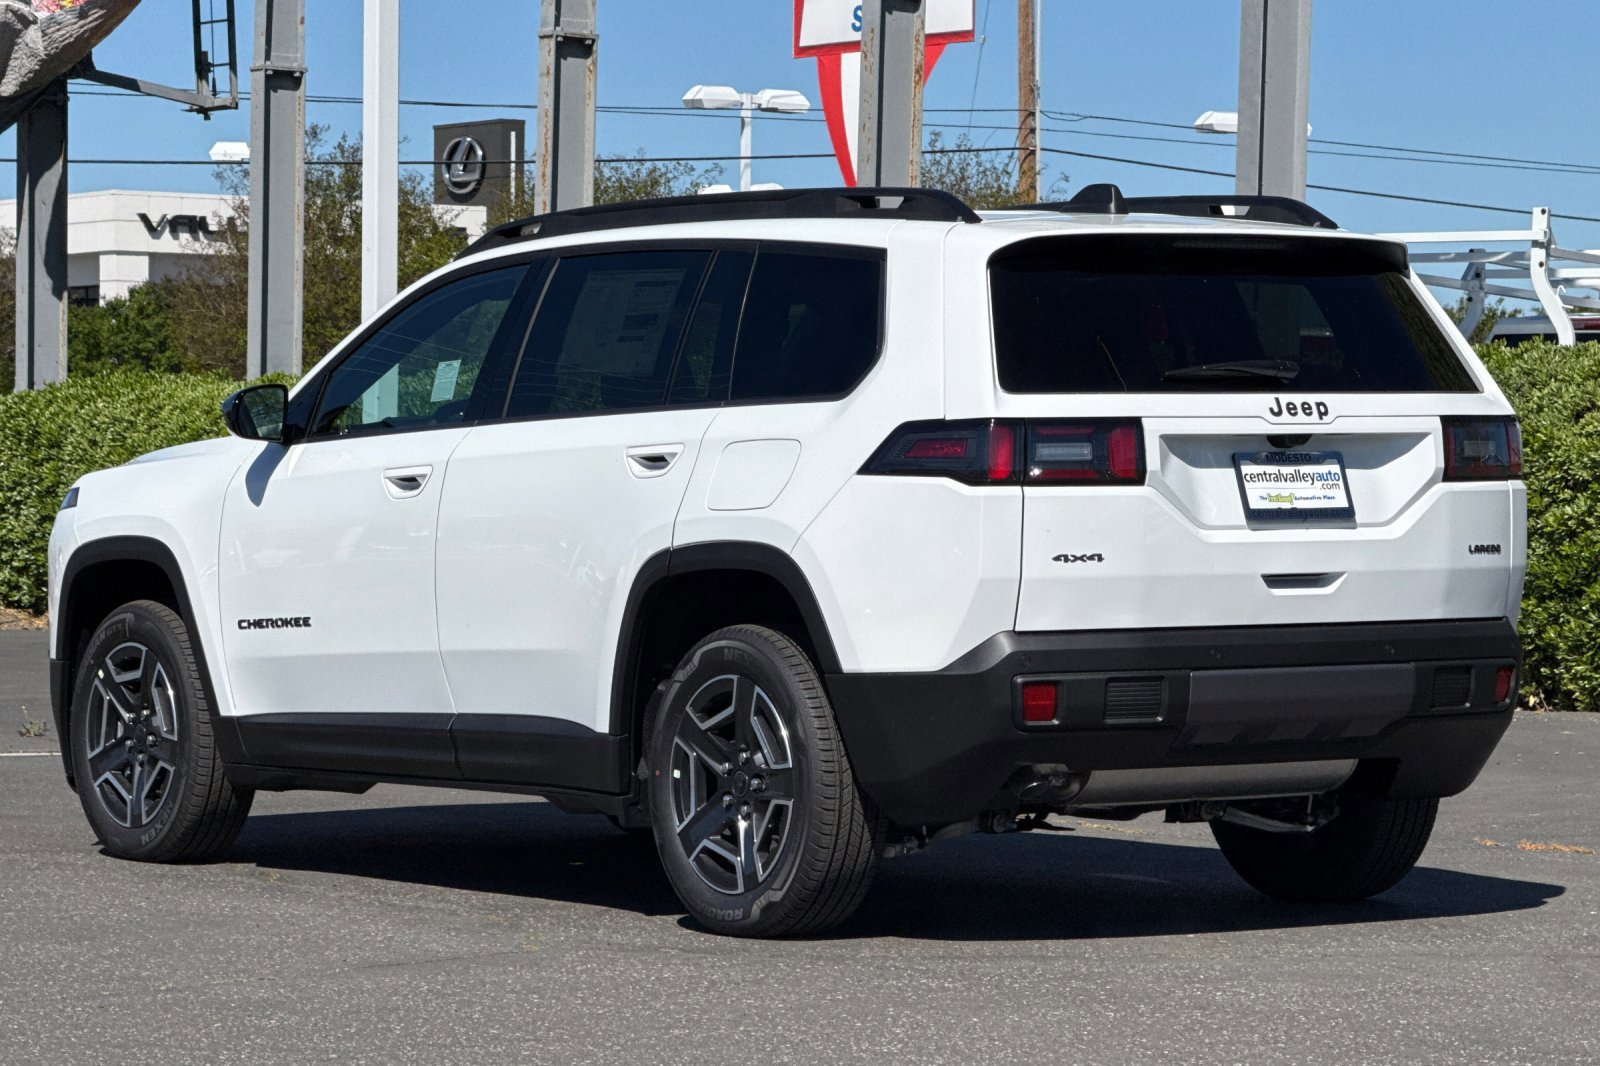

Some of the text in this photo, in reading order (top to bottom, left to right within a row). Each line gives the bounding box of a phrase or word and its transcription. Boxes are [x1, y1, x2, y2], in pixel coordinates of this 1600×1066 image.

[1269, 397, 1329, 420] Jeep
[1265, 453, 1312, 463] MODESTO
[1243, 469, 1341, 486] centralvalleyauto
[1468, 544, 1501, 555] LAREDO
[237, 616, 312, 630] CHEROKEE
